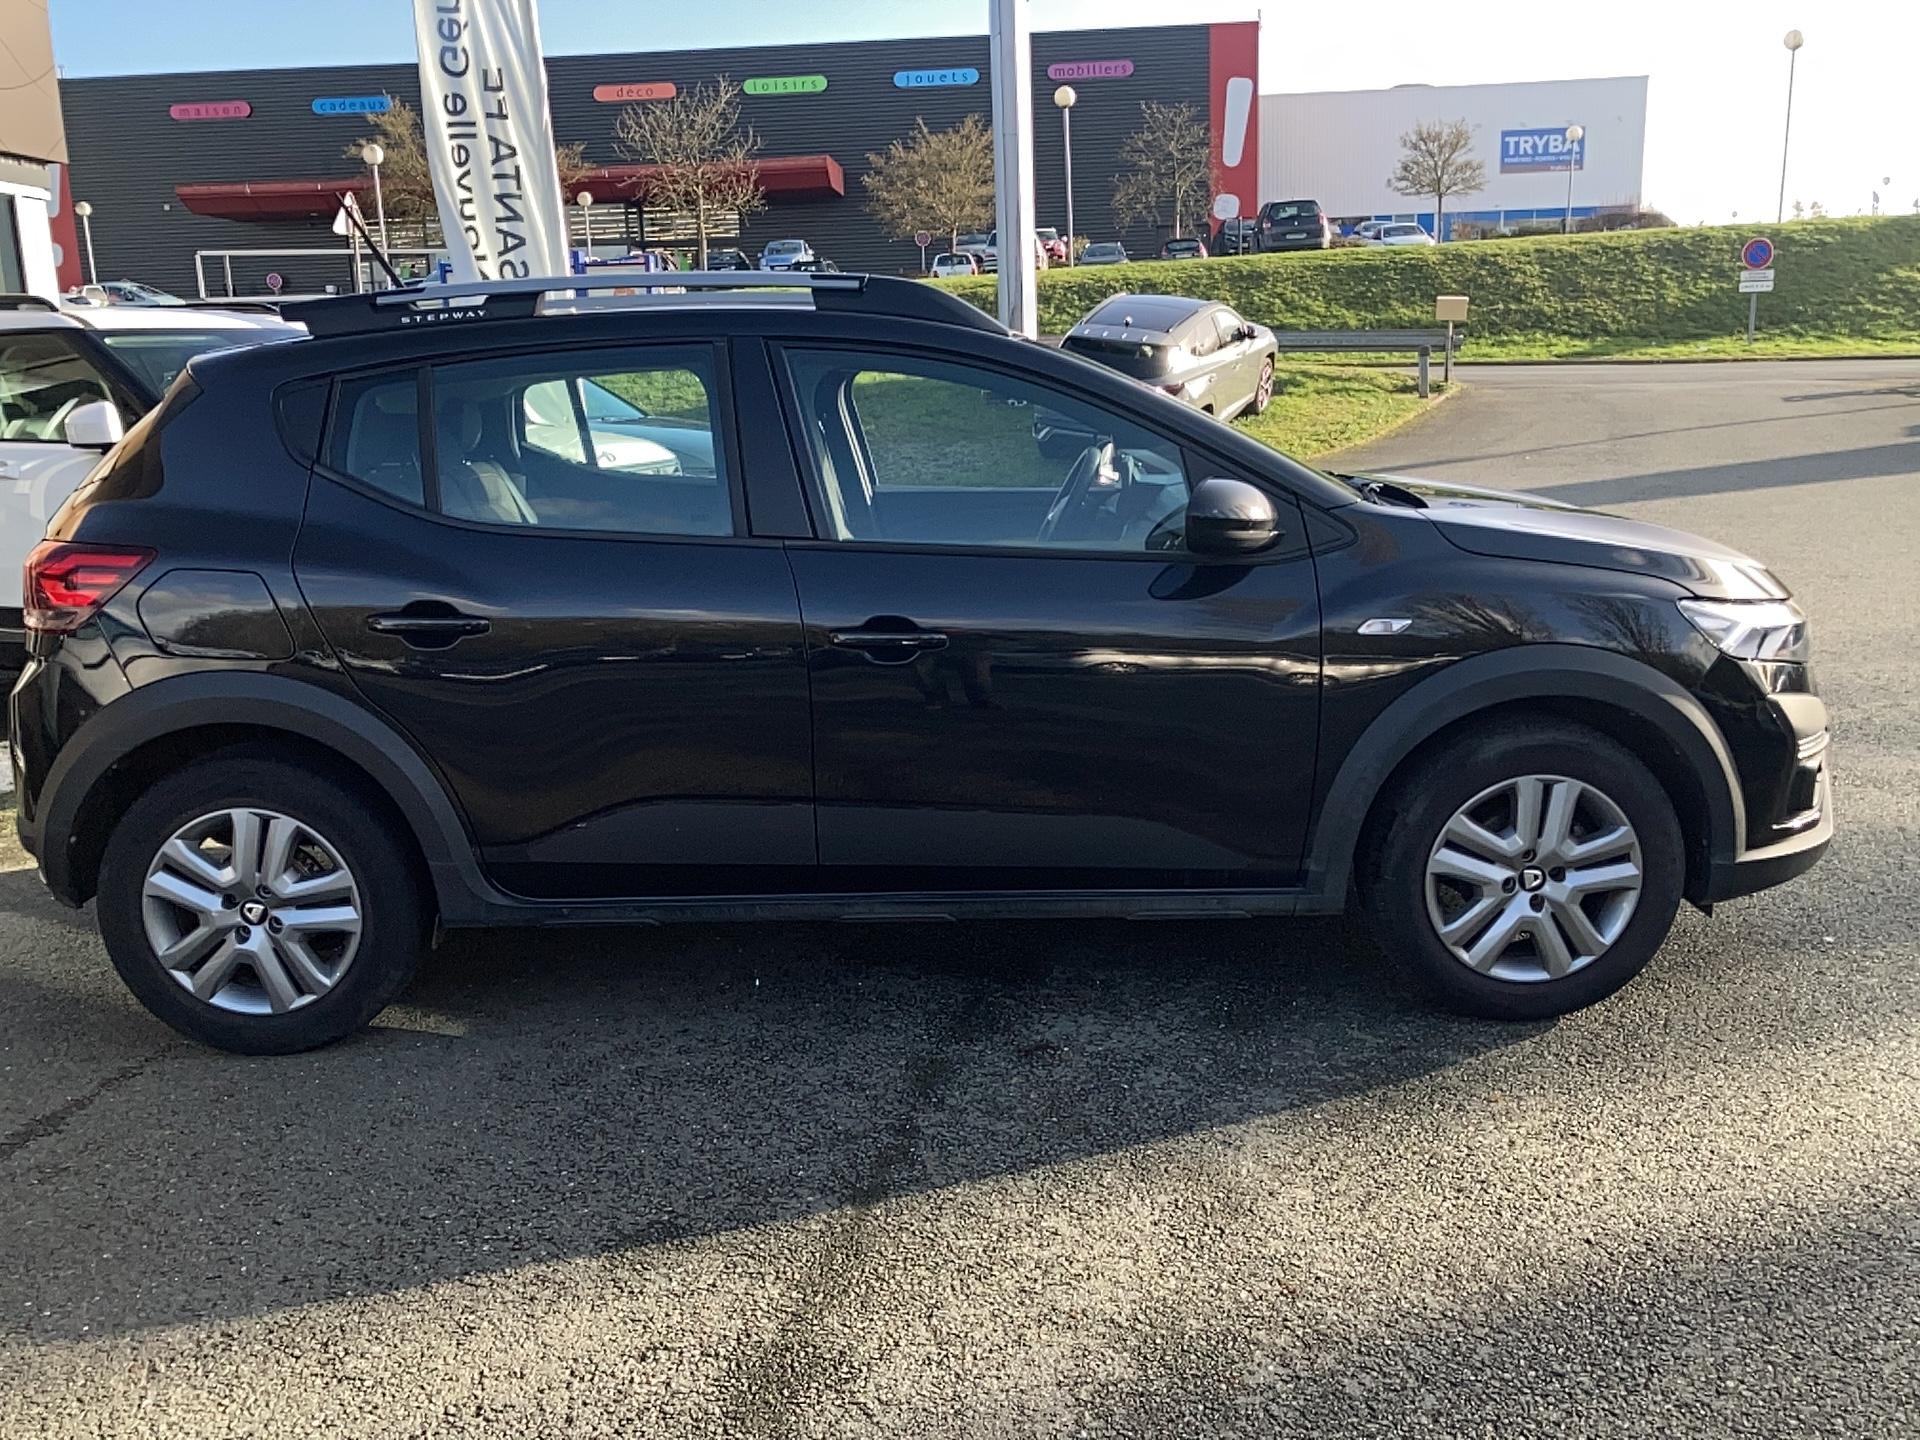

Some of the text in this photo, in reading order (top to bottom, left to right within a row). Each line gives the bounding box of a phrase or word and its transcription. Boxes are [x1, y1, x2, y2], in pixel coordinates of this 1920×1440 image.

[1054, 62, 1128, 77] mobiliers
[752, 79, 818, 92] loisirs
[904, 72, 969, 86] jouets
[616, 86, 654, 98] déco
[178, 104, 242, 117] maison
[319, 99, 386, 112] cadeaux
[1504, 134, 1580, 155] TRYBA
[401, 310, 486, 323] STEPWAY
